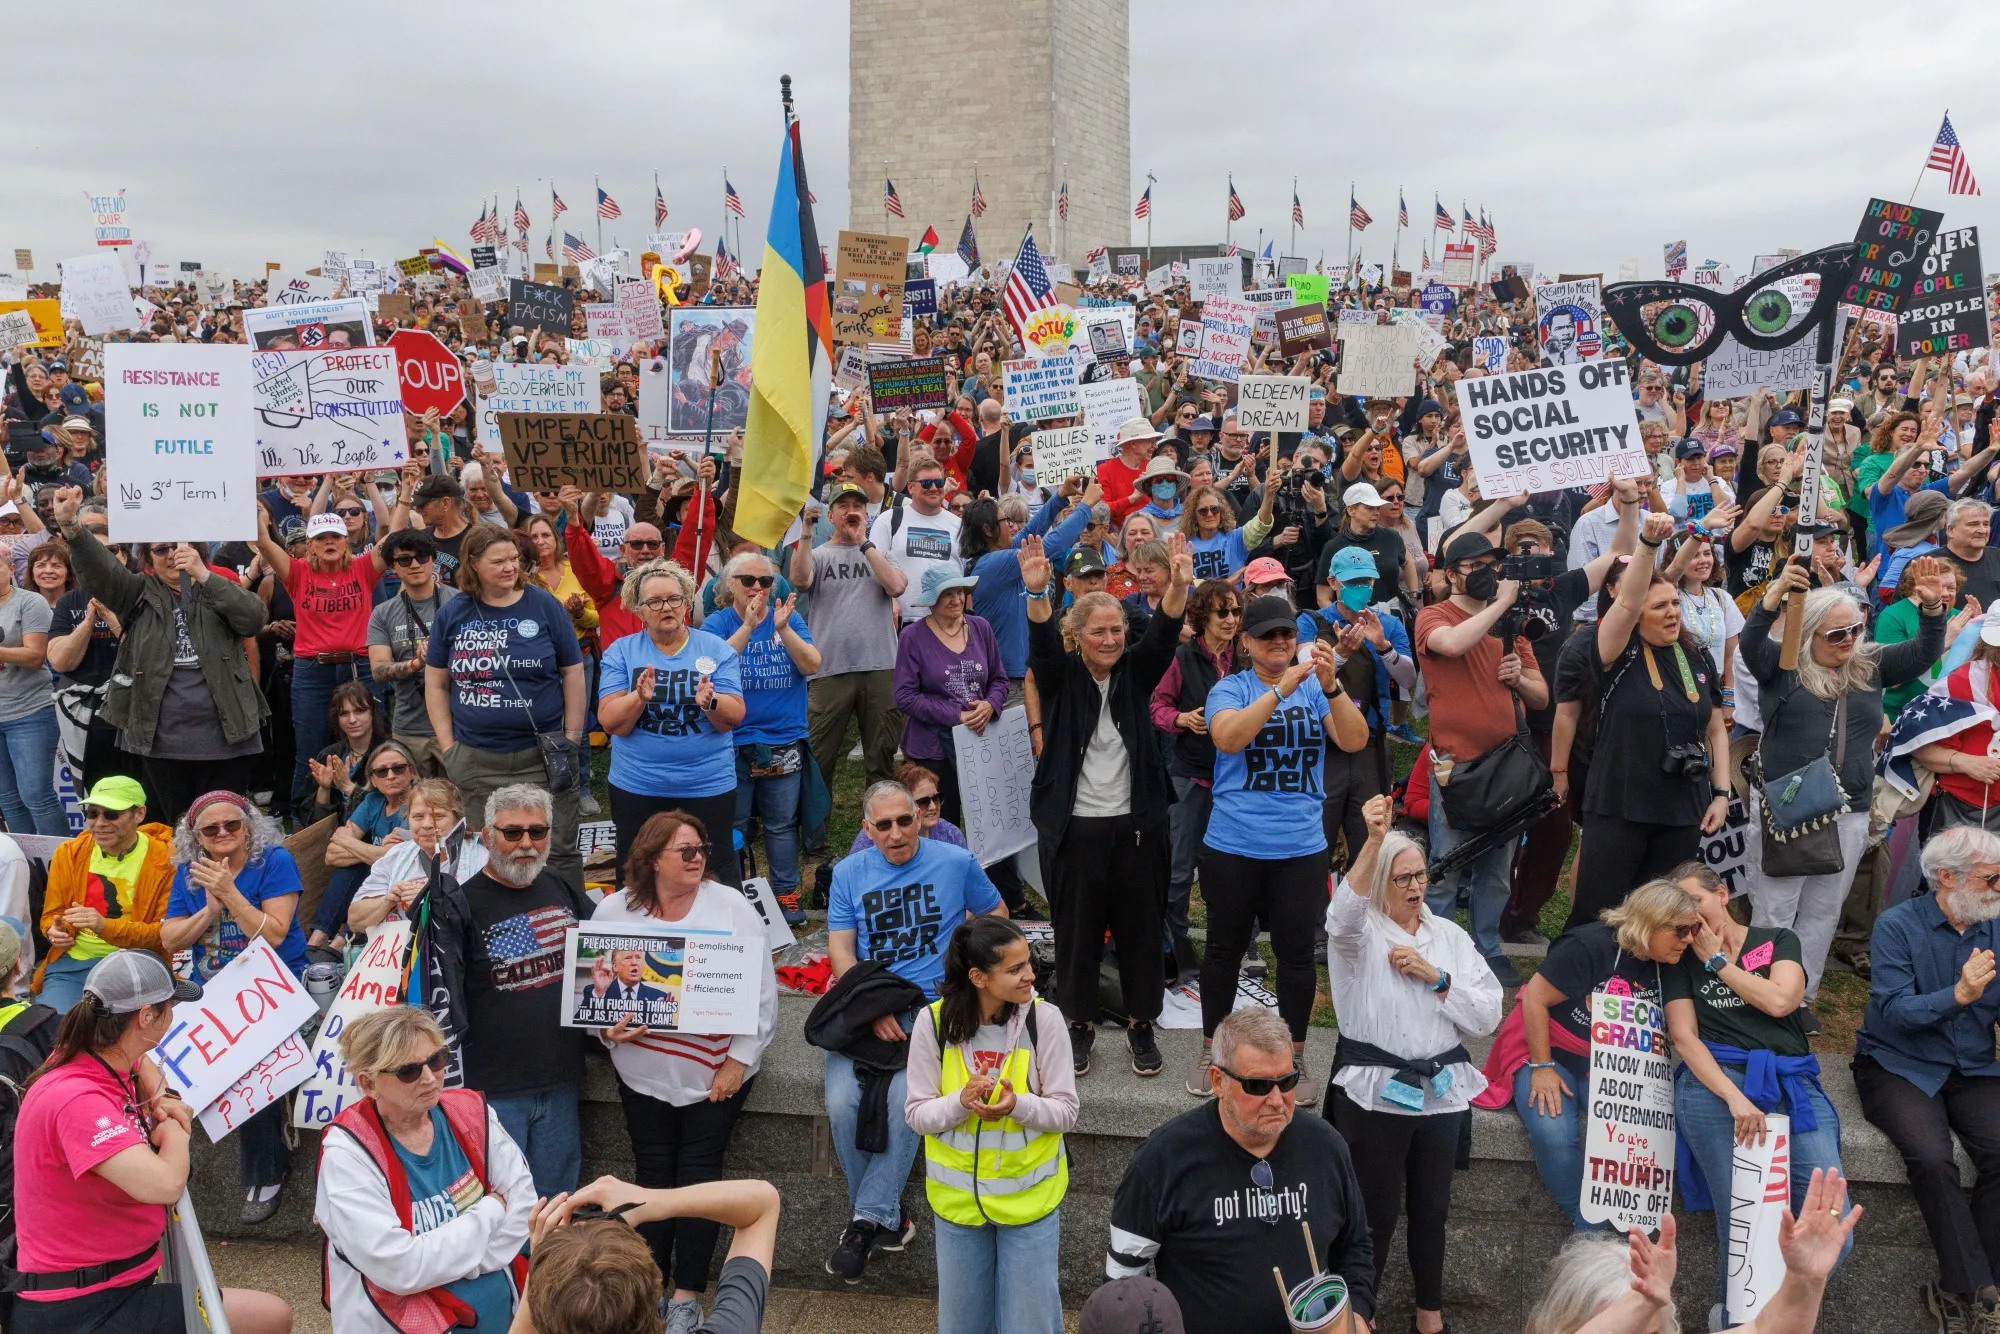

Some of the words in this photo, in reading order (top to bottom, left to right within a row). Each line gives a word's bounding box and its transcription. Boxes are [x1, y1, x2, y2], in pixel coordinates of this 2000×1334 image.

[91, 197, 126, 213] DEFEND
[1869, 201, 1921, 225] HANDS
[98, 214, 121, 225] OUR
[1879, 221, 1914, 240] OFF!
[1118, 255, 1138, 265] FIGHT
[1922, 253, 1952, 275] OF
[1119, 266, 1139, 276] BACK
[1199, 263, 1233, 276] TRUMP
[1695, 271, 1722, 285] ELON,
[1859, 267, 1902, 288] HAND
[289, 279, 310, 289] NO
[621, 282, 654, 298] STOP
[1428, 285, 1445, 293] ELECT
[1537, 285, 1566, 301] Rising
[1575, 280, 1596, 298] Meet
[1244, 292, 1272, 302] HANDS
[1275, 290, 1292, 300] OFF!
[1422, 291, 1452, 300] FEMINISTS
[1847, 285, 1900, 310] CUFFS!
[266, 311, 286, 320] QUIT
[288, 309, 309, 317] YOUR
[312, 306, 344, 315] FASCIST
[514, 303, 567, 326] FACISM
[859, 305, 892, 322] DOGE
[1551, 295, 1575, 309] Moral
[1576, 296, 1600, 322] Moment
[1898, 297, 1983, 324] PEOPLE
[286, 316, 328, 325] TAKEOVER
[835, 320, 874, 337] Tariffs
[1282, 321, 1293, 330] TAX
[1293, 318, 1304, 327] THE
[1304, 314, 1323, 325] GREEDY
[1931, 319, 1955, 334] IN
[597, 328, 623, 336] MUSK
[1284, 322, 1325, 340] BILLIONAIRES
[1358, 325, 1416, 343] PRESIDENT
[570, 340, 612, 358] HANDS
[1374, 343, 1397, 355] OUR
[1475, 337, 1505, 357] STAND
[1911, 333, 1970, 355] POWER
[322, 355, 390, 371] PROTECT
[1042, 356, 1074, 368] AMERICA
[1210, 351, 1243, 366] ACCEPT
[1344, 355, 1416, 374] EMPLOYEE
[1711, 358, 1732, 372] and
[1738, 350, 1778, 368] HELP
[122, 370, 221, 386] RESISTANCE
[521, 369, 555, 381] LIKE
[565, 370, 582, 382] MY
[872, 370, 893, 378] BLACK
[1011, 374, 1022, 383] NO
[1024, 372, 1043, 382] LAWS
[1707, 376, 1725, 389] the
[1730, 369, 1763, 389] SOUL
[346, 380, 377, 394] OUR
[875, 388, 910, 397] SCIENCE
[923, 384, 944, 392] REAL
[1007, 386, 1017, 395] NO
[1021, 382, 1045, 393] RIGHTS
[1242, 383, 1305, 400] REDEEM
[1467, 370, 1566, 408] HANDS
[1579, 359, 1626, 390] OFF
[876, 397, 900, 407] LOVE
[919, 392, 945, 403] LOVE
[1021, 396, 1036, 406] ALL
[1039, 391, 1067, 403] PROFITS
[1085, 388, 1113, 398] Fascism
[142, 402, 160, 417] IS
[179, 402, 219, 417] NOT
[315, 400, 404, 418] CONSTITUTION
[488, 399, 519, 410] LIKE
[537, 400, 566, 411] LIKE
[574, 401, 590, 411] MY
[1026, 403, 1079, 420] BILLIONAIRES
[1241, 410, 1300, 427] DREAM
[1474, 400, 1579, 439] SOCIAL
[513, 417, 626, 442] IMPEACH
[155, 440, 214, 454] FUTILE
[1037, 429, 1089, 450] BULLIES
[1496, 425, 1629, 469] SECURITY
[512, 441, 549, 465] VP
[554, 440, 638, 466] TRUMP
[1062, 449, 1082, 457] WHEN
[514, 466, 578, 492] PRES
[582, 465, 644, 489] MUSK
[1037, 468, 1069, 487] FIGHT
[1484, 466, 1542, 494] IT'S
[1550, 450, 1646, 485] SOLVENT
[120, 482, 142, 502] No
[150, 479, 171, 501] 3rd
[913, 549, 942, 558] impeach
[315, 595, 364, 613] LIBERTY
[455, 629, 508, 640] STRONG
[461, 620, 498, 634] HERE'S
[502, 618, 519, 629] TO
[453, 650, 475, 659] MAY
[451, 655, 511, 673] KNOW
[511, 659, 543, 668] THEM,
[755, 665, 791, 677] SEXUALITY
[764, 677, 792, 690] CHOICE
[459, 691, 501, 707] RAISE
[503, 699, 533, 708] THEM
[1009, 714, 1034, 775] TRUMP
[999, 729, 1021, 831] DICTATOR
[960, 743, 985, 857] DICTATORS
[985, 776, 1005, 831] LOVES
[583, 937, 618, 950] PLEASE
[619, 939, 630, 950] BE
[689, 941, 744, 953] D-emolishing
[688, 955, 708, 964] O-ur
[687, 970, 743, 980] G-overnment
[685, 984, 735, 994] E-fficiencies
[589, 997, 604, 1009] I'M
[606, 999, 644, 1012] FUCKING
[646, 1001, 678, 1013] THINGS
[155, 947, 295, 1088] FELON
[579, 1009, 592, 1021] UP
[594, 1010, 606, 1021] AS
[632, 1013, 643, 1023] AS
[651, 1013, 673, 1025] CAN!
[1591, 1021, 1672, 1059] GRADERS
[1594, 1050, 1640, 1076] KNOW
[1644, 1060, 1672, 1082] MORE
[1598, 1077, 1643, 1102] ABOUT
[1593, 1100, 1675, 1132] GOVERNMENT!
[1605, 1122, 1648, 1150] You're
[1627, 1147, 1659, 1168] Fired.
[1589, 1156, 1671, 1193] TRUMP!
[1214, 1190, 1240, 1226] got
[1245, 1182, 1308, 1220] liberty?
[1590, 1186, 1641, 1211] HANDS
[1647, 1193, 1669, 1214] OFF
[1617, 1211, 1657, 1226] 4/5/2025
